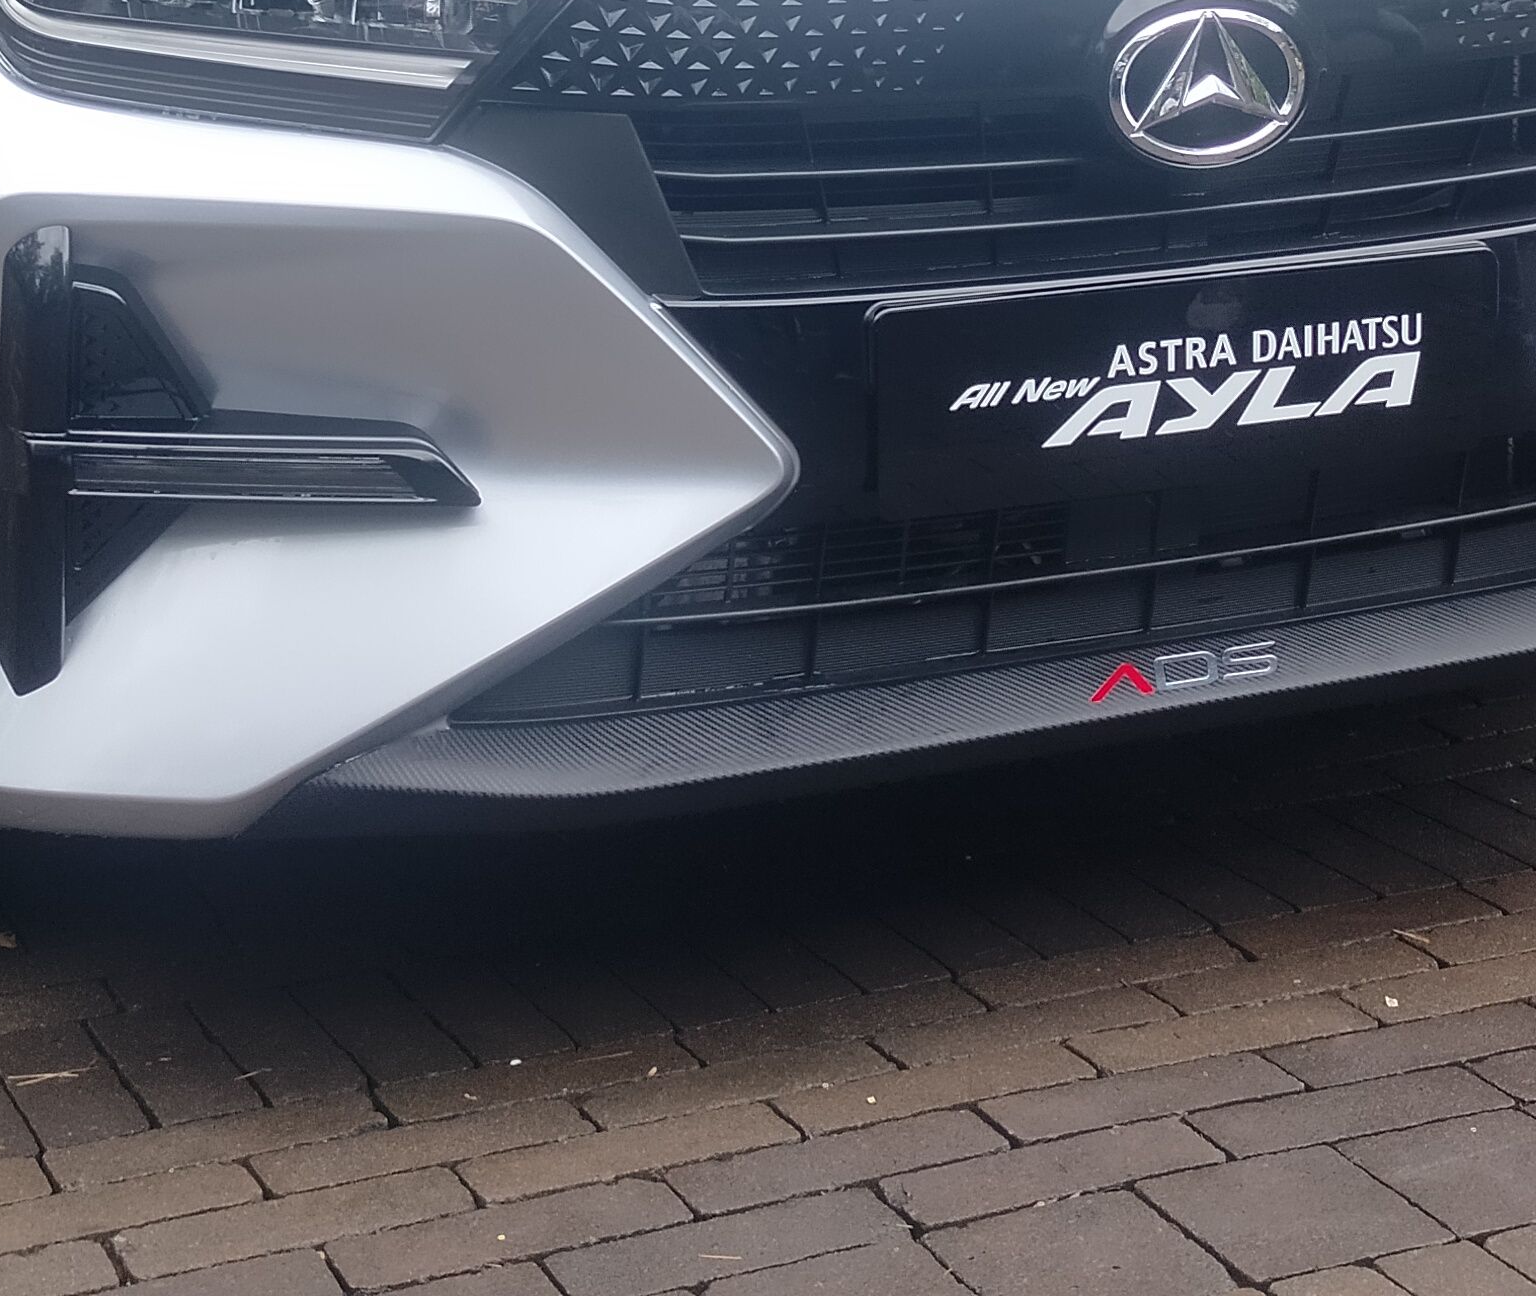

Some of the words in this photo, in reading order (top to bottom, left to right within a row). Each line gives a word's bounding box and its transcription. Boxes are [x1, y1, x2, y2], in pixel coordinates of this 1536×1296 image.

[949, 380, 1011, 412] All
[1011, 376, 1102, 405] New
[1107, 333, 1237, 379] ASTRA
[1251, 312, 1422, 364] DAIHATSU
[1040, 350, 1421, 448] AYLA
